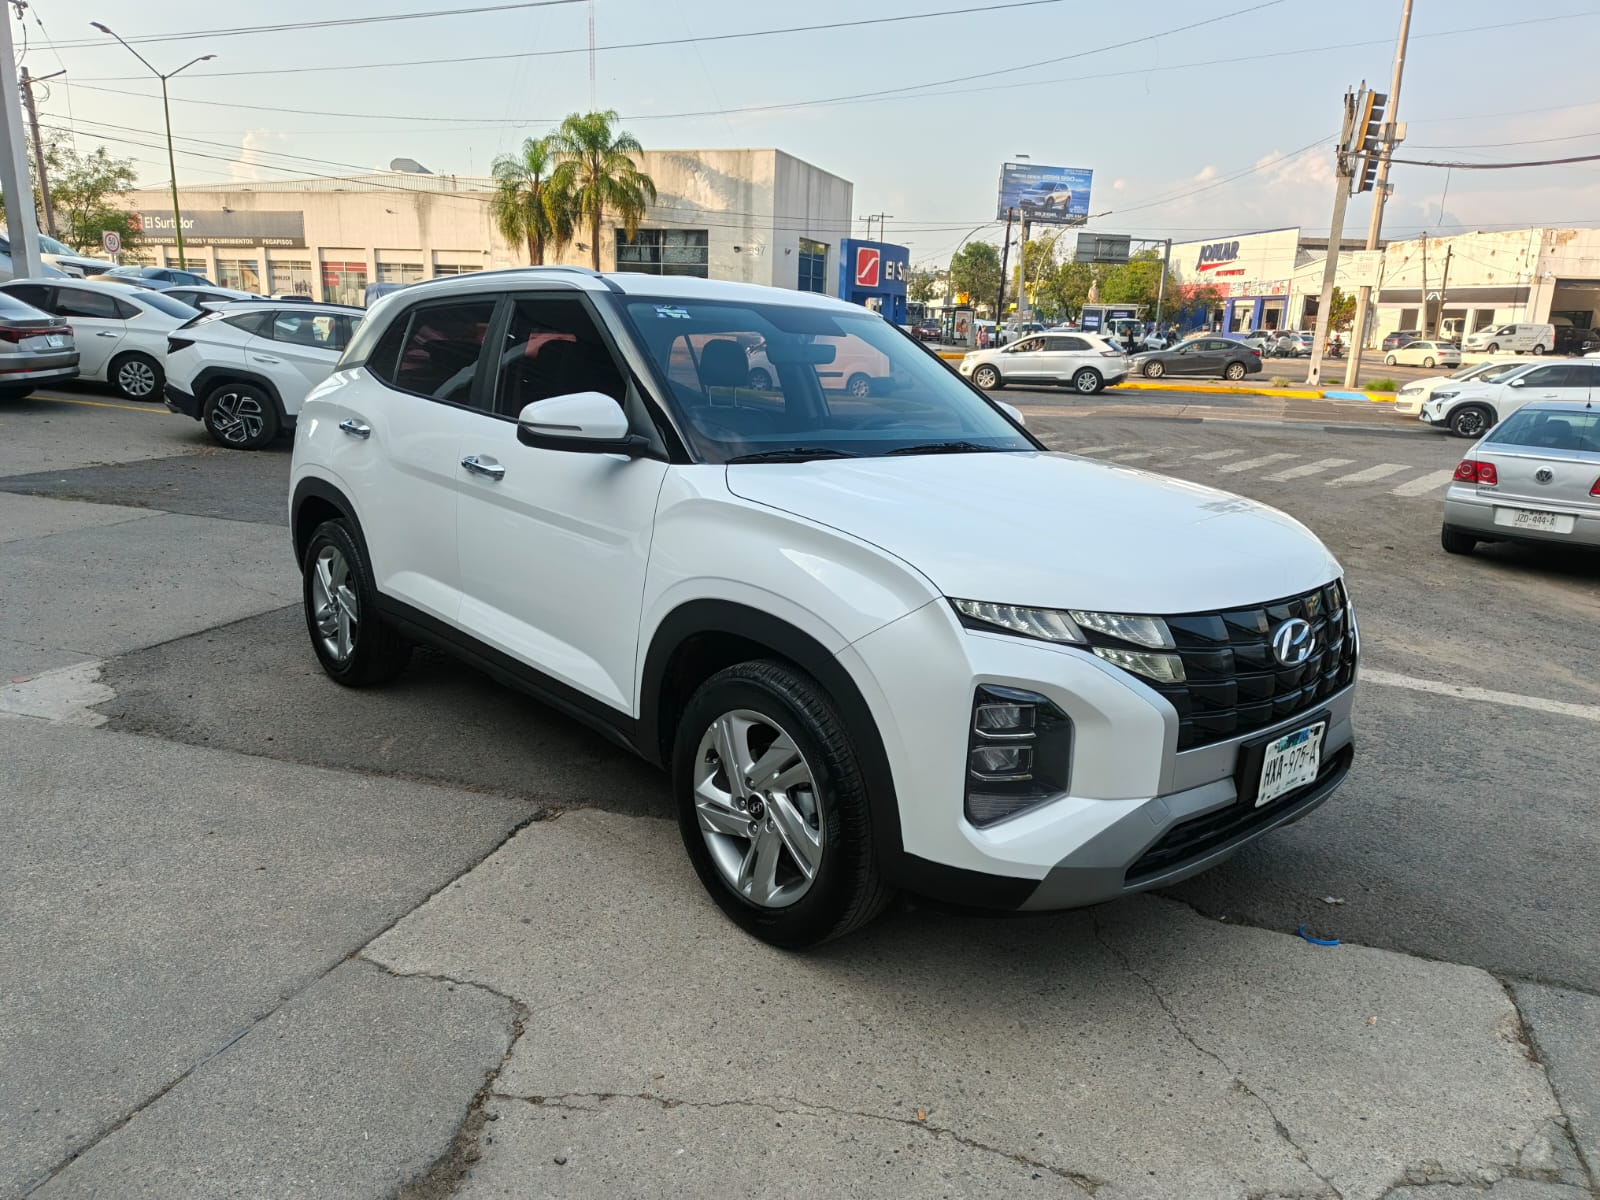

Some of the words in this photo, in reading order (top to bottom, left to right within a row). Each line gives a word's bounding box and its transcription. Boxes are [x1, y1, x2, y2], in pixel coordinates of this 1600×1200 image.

[145, 216, 153, 229] El
[155, 216, 194, 229] Surtdor
[262, 238, 293, 246] PEGAPISOS
[1196, 241, 1240, 271] JOMAR
[885, 260, 895, 281] El
[1264, 740, 1317, 786] HXA-975-A
